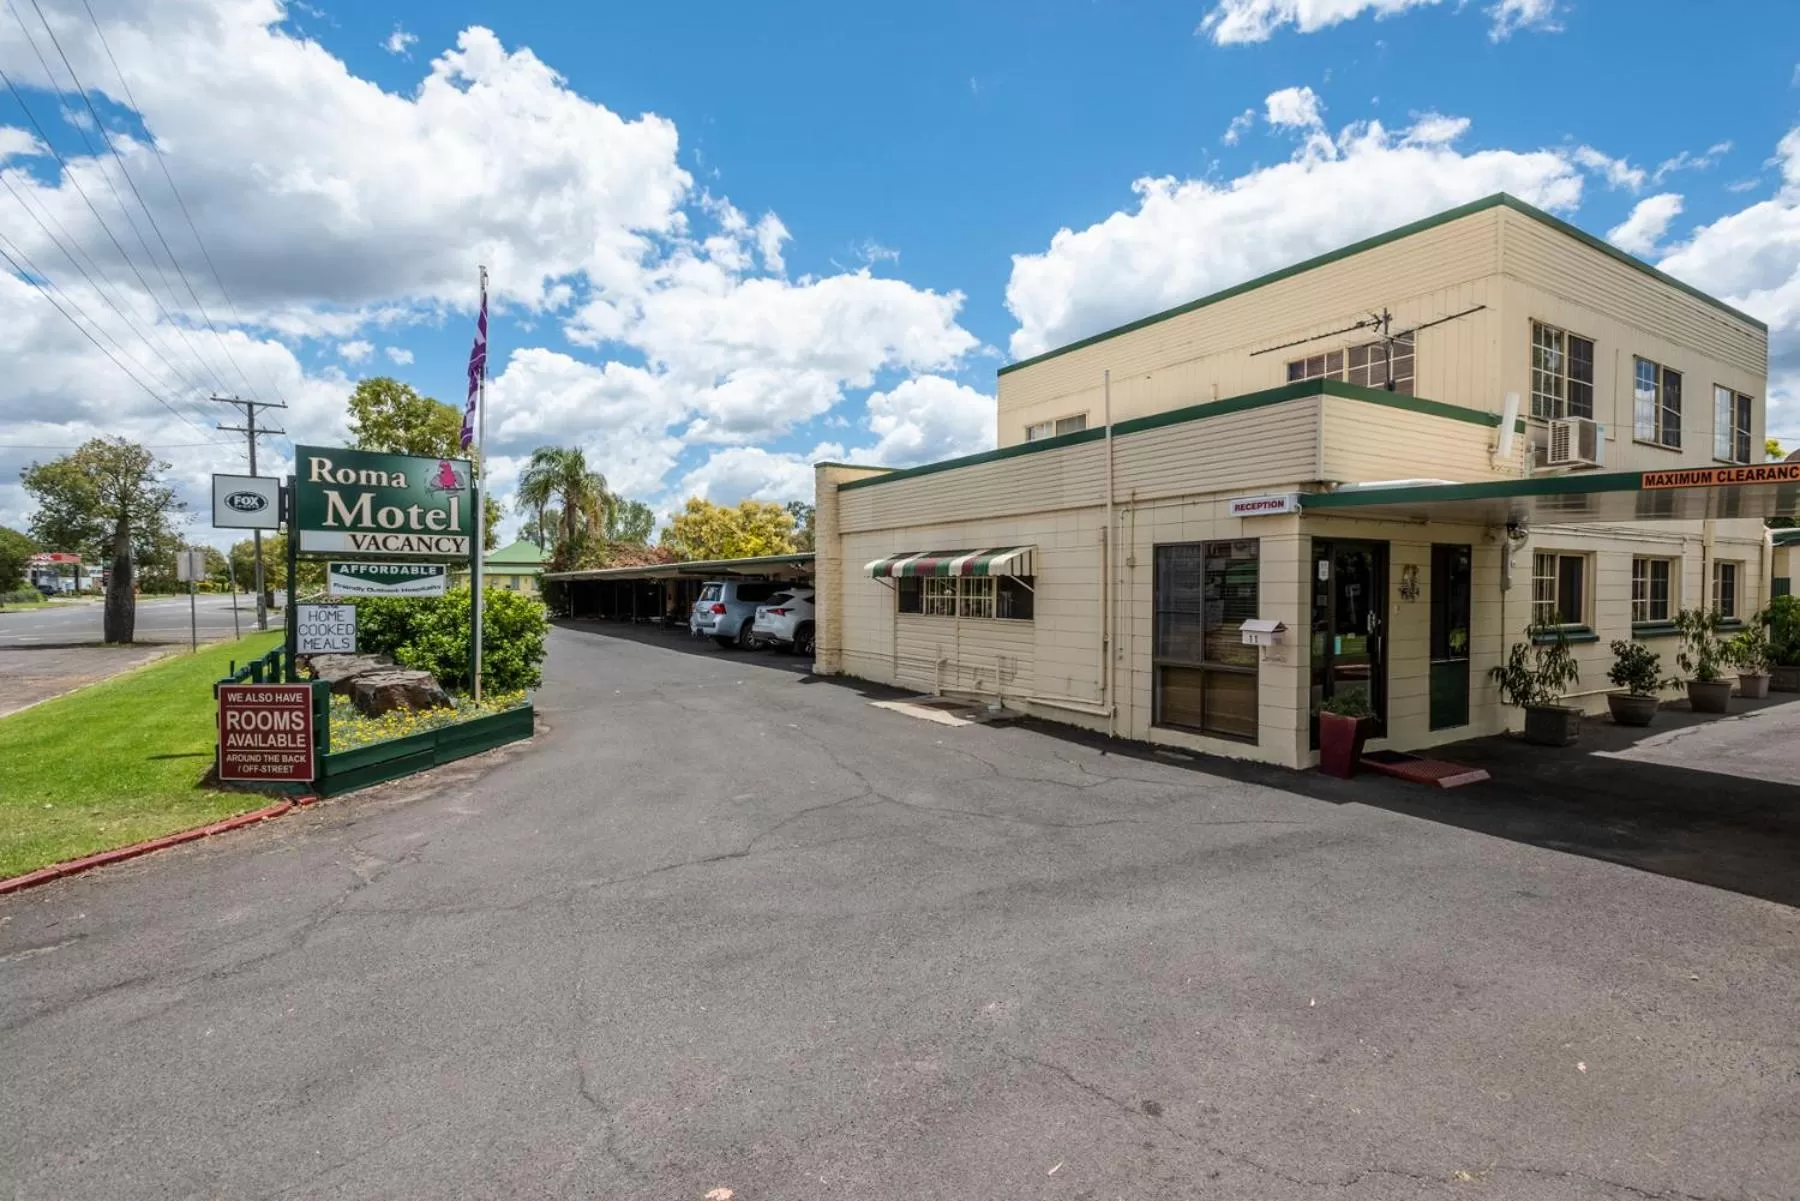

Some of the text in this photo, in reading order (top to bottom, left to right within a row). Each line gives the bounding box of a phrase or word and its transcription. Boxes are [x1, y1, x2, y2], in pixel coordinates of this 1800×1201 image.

[307, 456, 409, 488] Roma
[1644, 471, 1712, 487] MAXIMUM
[234, 495, 259, 506] FOX
[1234, 499, 1285, 512] RECEPTION
[322, 490, 461, 531] Motel
[350, 534, 465, 552] VACANCY
[339, 564, 437, 575] AFFORDABLE
[308, 610, 345, 622] HOME
[298, 623, 355, 636] COOKED
[303, 637, 350, 650] MEALS
[227, 692, 304, 703] WE ALSO HAVE
[226, 710, 305, 731] ROOMS
[226, 733, 307, 748] AVAILABLE
[226, 754, 307, 763] AROUND THE BACK
[242, 764, 294, 774] OFF-STREET
